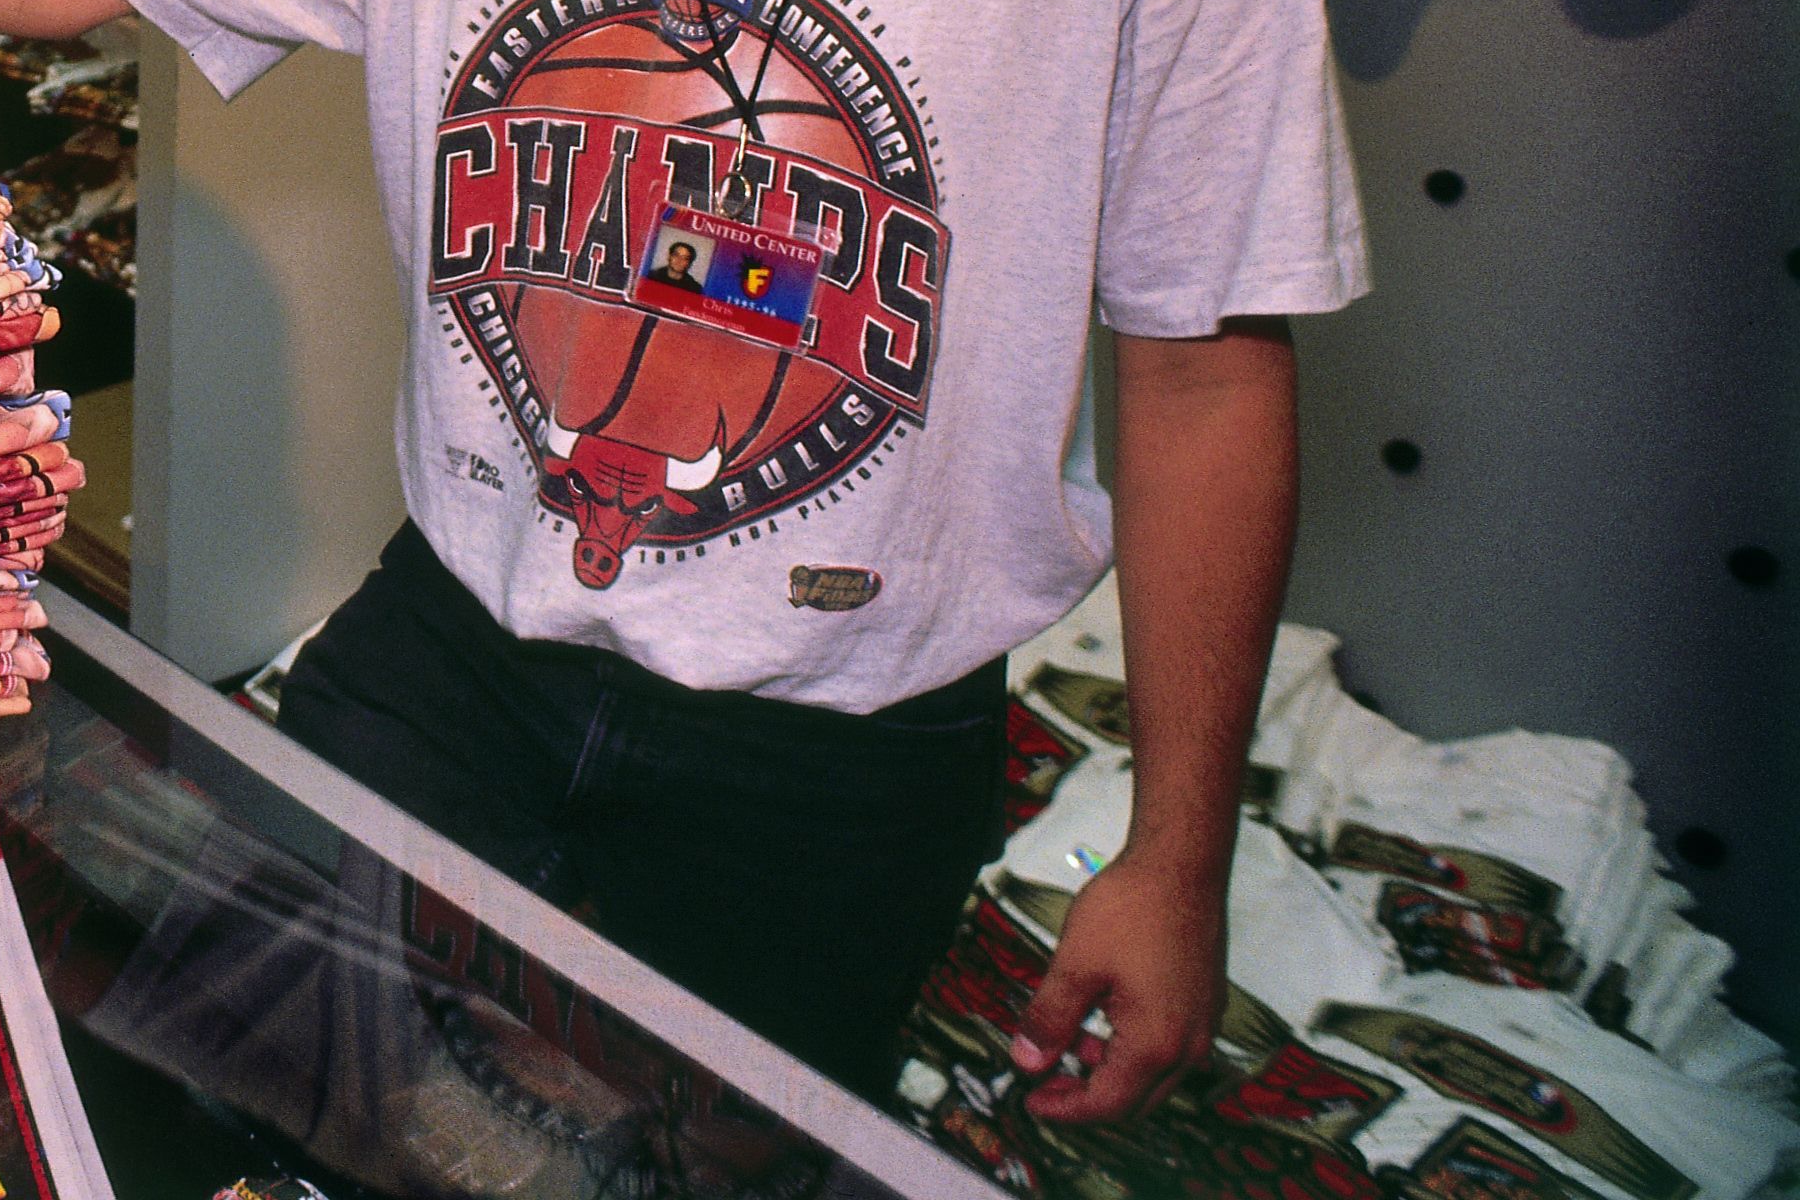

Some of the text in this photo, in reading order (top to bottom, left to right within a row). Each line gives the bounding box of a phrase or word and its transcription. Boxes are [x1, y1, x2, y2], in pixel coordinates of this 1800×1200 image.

[691, 214, 817, 264] UNITED CENTER
[467, 291, 876, 512] CHICAGO BULLS
[729, 517, 779, 548] NBA
[798, 425, 908, 521] PLAYOFFS
